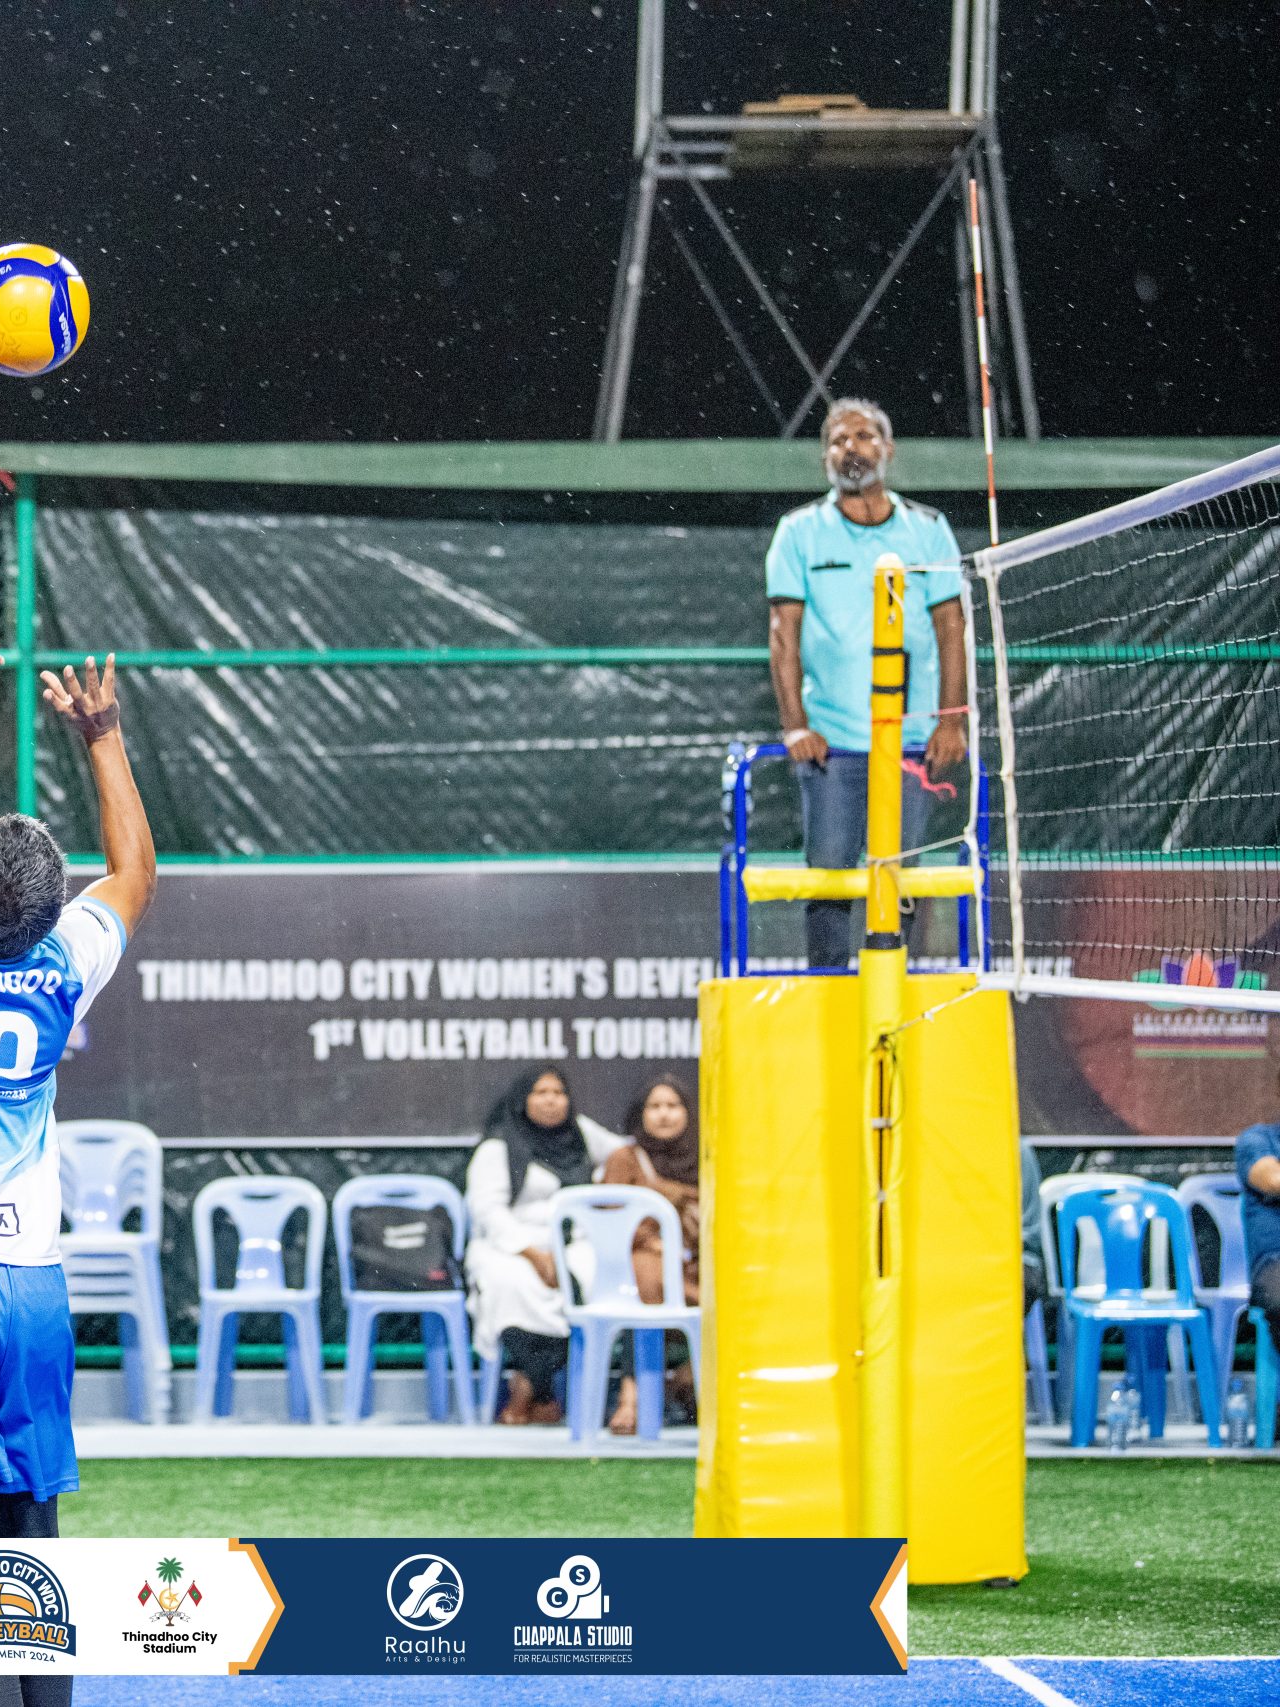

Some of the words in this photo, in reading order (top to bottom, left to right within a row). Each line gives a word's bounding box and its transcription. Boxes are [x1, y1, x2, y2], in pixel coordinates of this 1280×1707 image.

[137, 959, 344, 1000] THINADHOO
[350, 958, 434, 1000] CITY
[437, 957, 608, 1000] WOMEN'S
[359, 1018, 568, 1060] VOLLEYBALL
